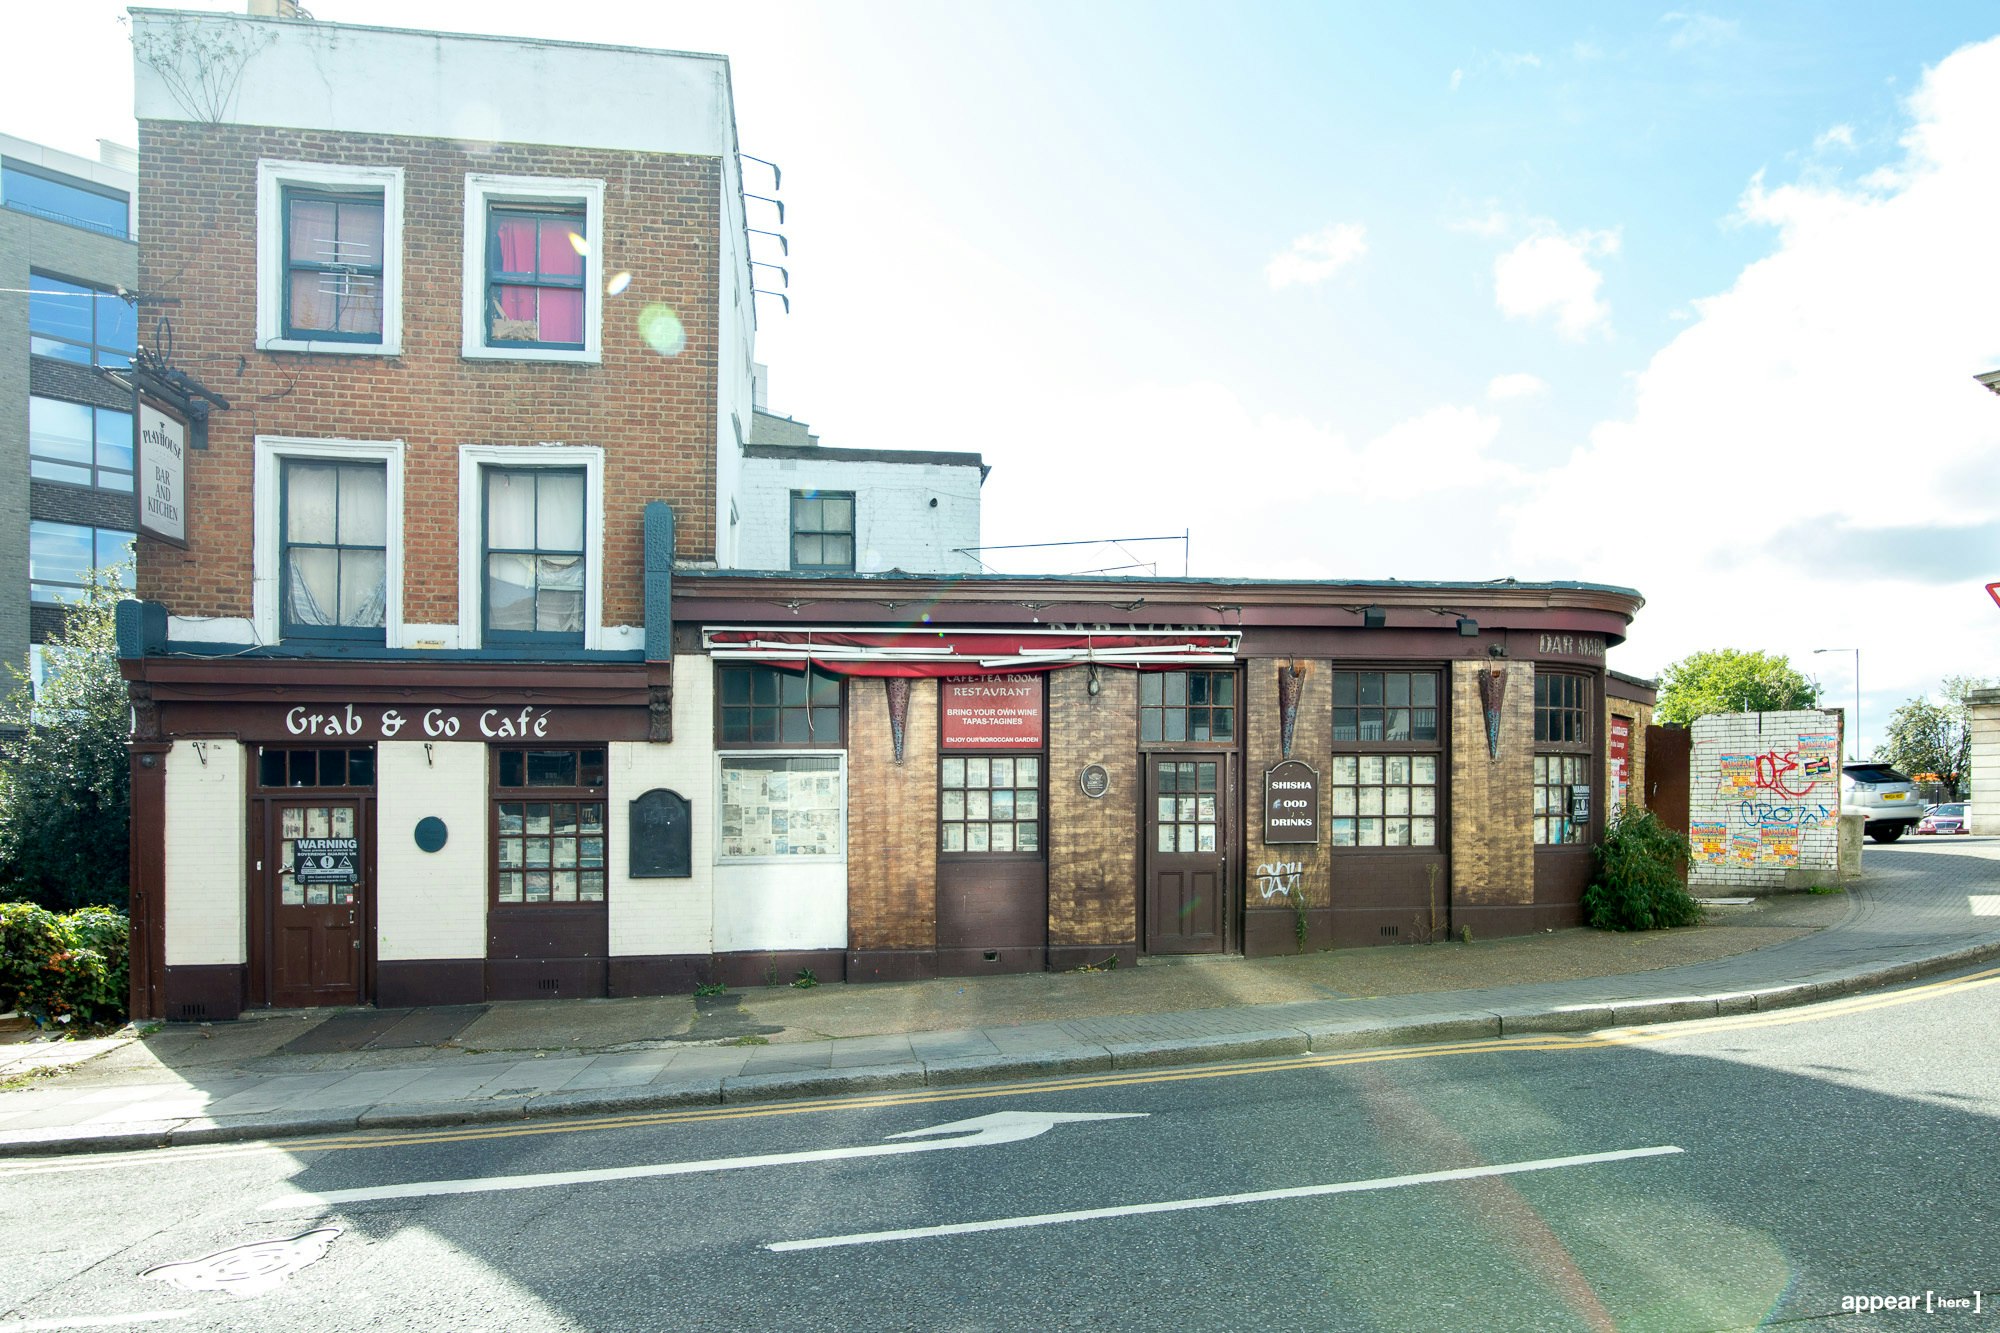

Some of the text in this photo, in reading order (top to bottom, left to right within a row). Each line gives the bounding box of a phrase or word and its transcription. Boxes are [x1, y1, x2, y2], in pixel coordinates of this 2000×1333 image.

[143, 429, 182, 460] PLAYHOUSE
[155, 465, 170, 486] BAR
[155, 483, 171, 502] AND
[147, 495, 178, 521] KITCHEN
[1540, 633, 1573, 655] DAR
[1007, 673, 1040, 683] ROOM
[954, 687, 1032, 697] RESTAURANT
[946, 708, 1038, 716] BRING YOUR OWN WINE
[286, 703, 552, 738] Grab & Go Café
[962, 717, 1023, 725] TAPAS-TAGINES
[1271, 818, 1312, 826] DRINKS
[297, 839, 358, 849] WARNING
